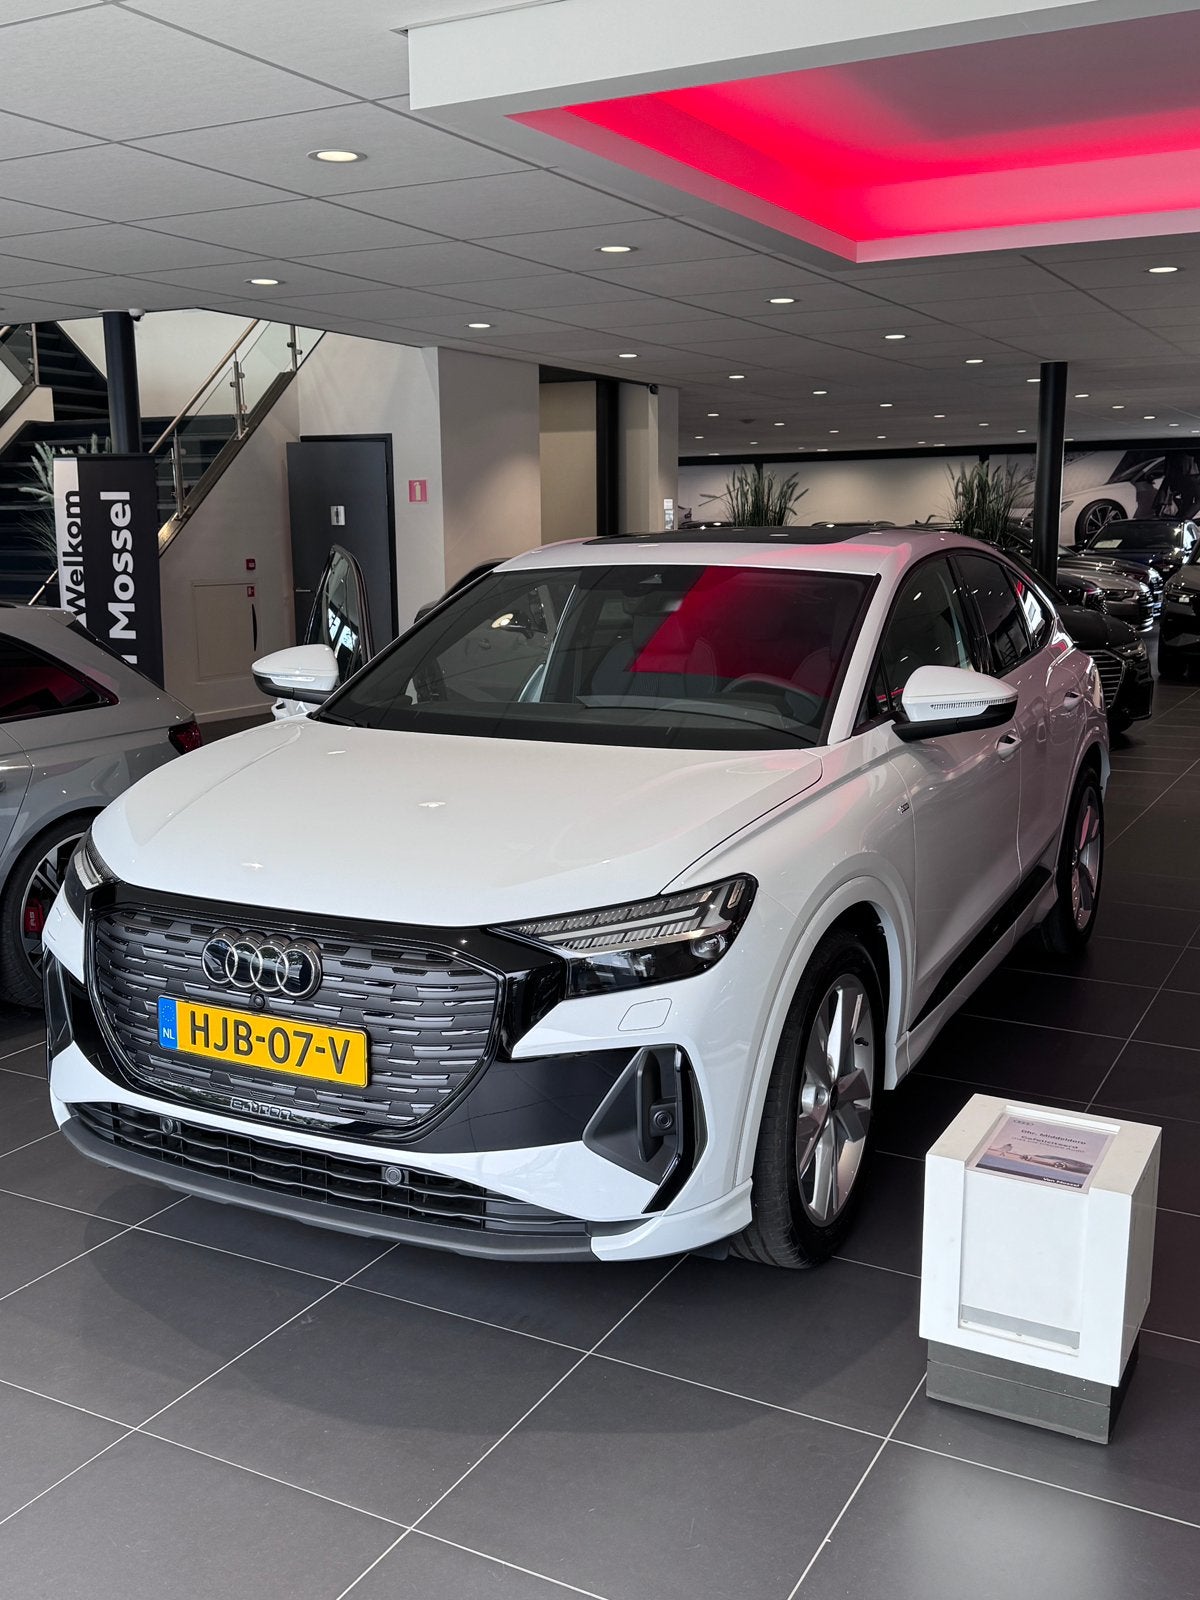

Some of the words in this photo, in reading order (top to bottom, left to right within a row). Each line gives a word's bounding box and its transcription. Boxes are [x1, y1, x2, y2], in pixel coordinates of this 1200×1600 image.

[62, 490, 87, 616] Welkom
[100, 491, 137, 640] Mossel
[162, 1027, 176, 1040] NL
[190, 1009, 350, 1075] HJB-07-V
